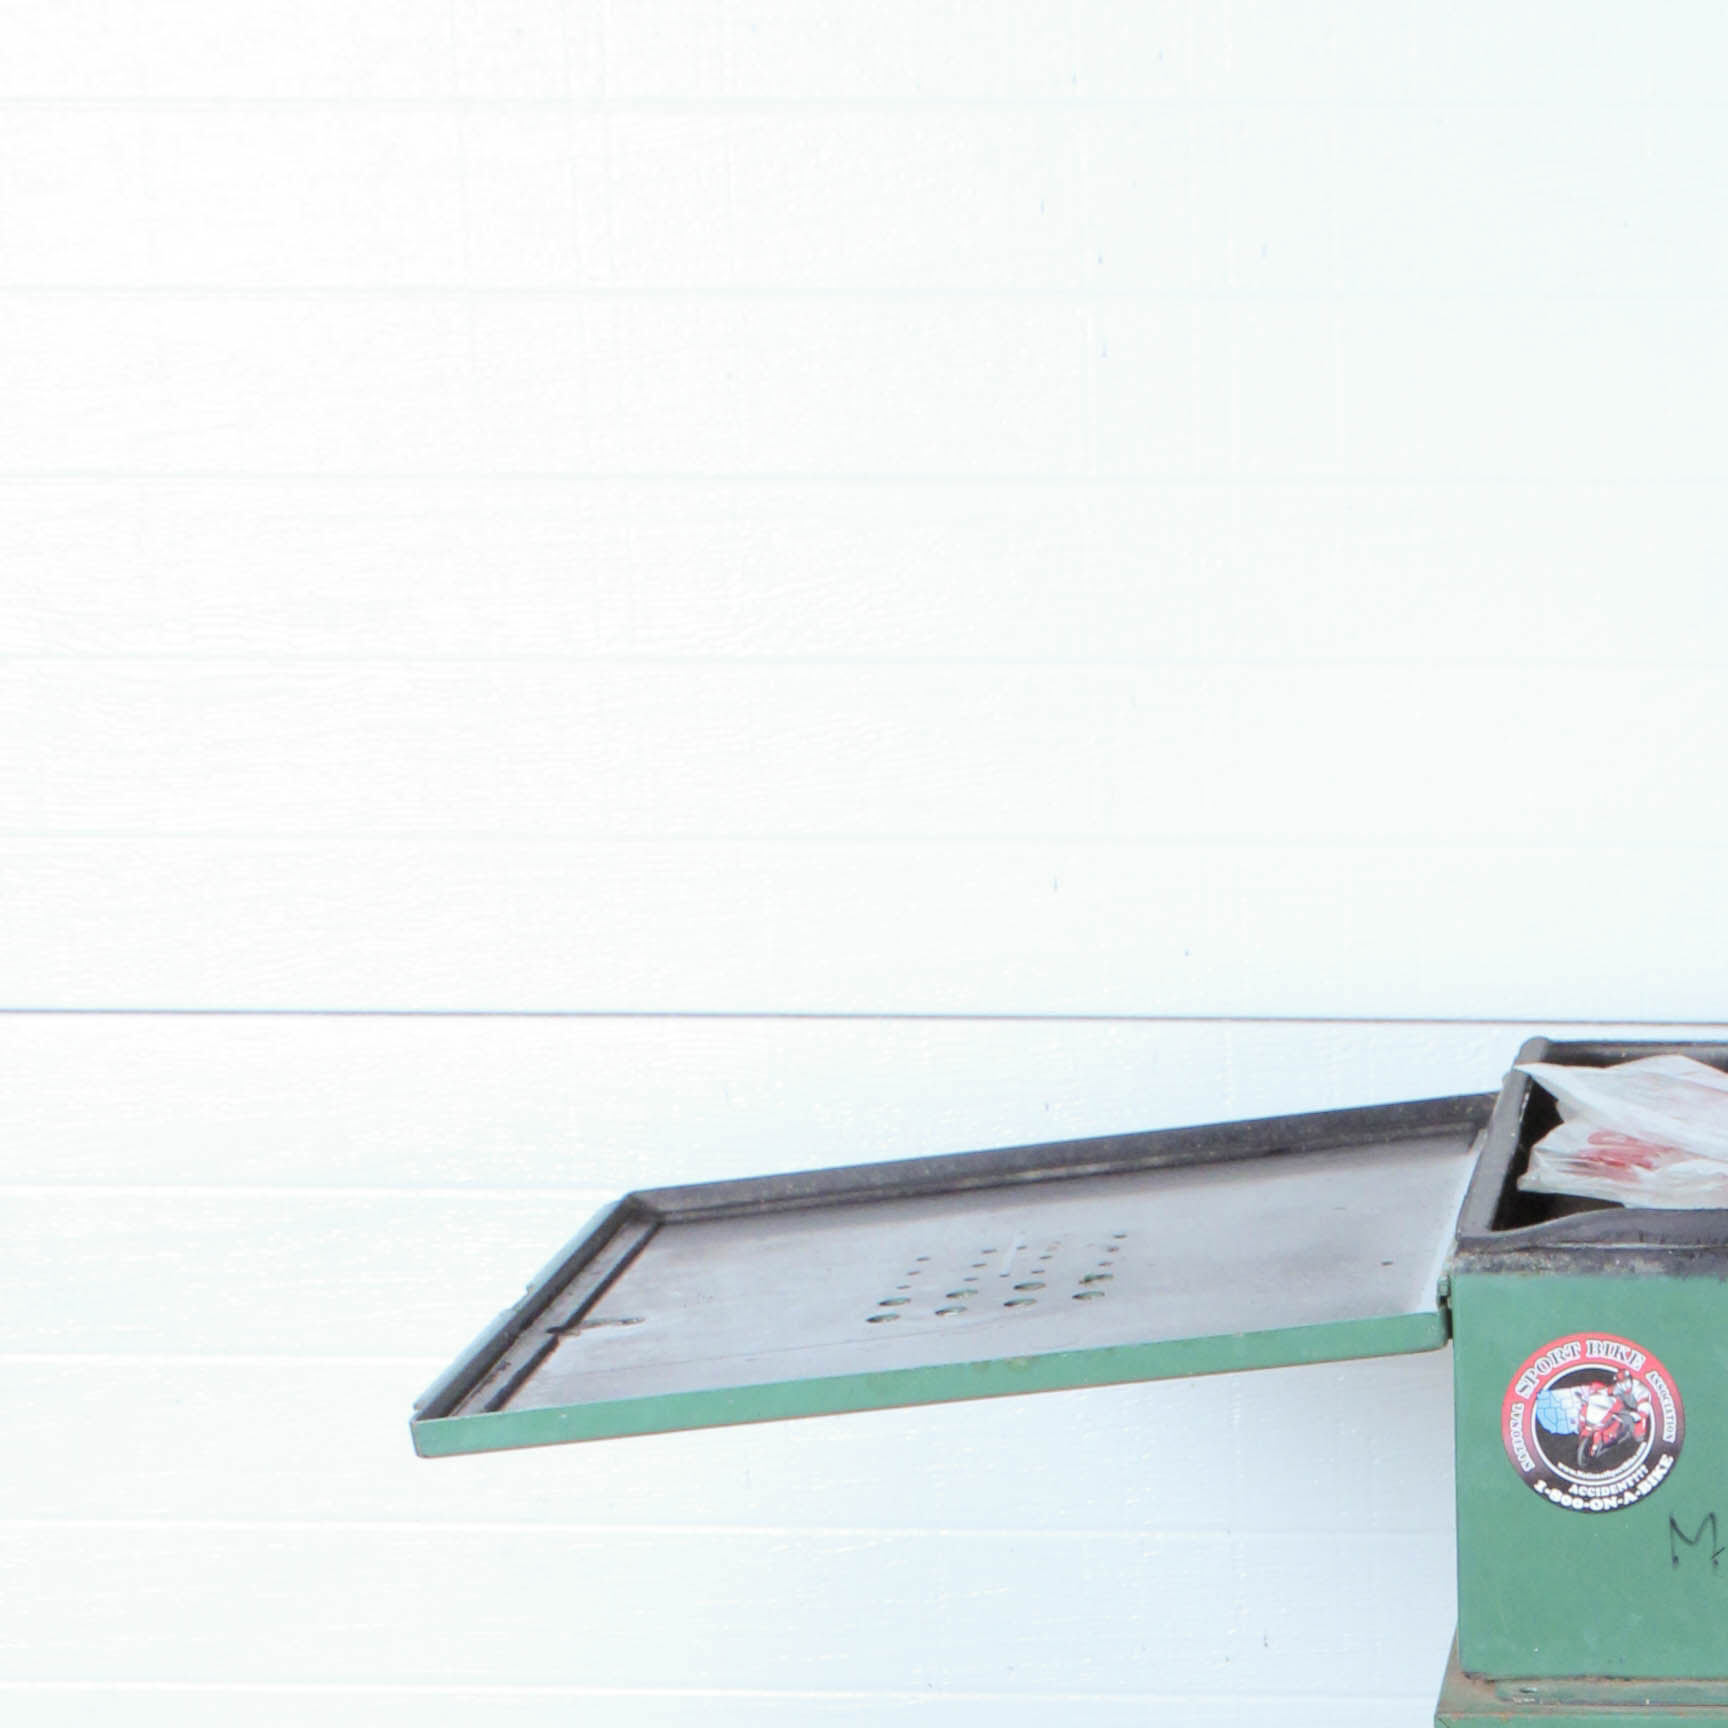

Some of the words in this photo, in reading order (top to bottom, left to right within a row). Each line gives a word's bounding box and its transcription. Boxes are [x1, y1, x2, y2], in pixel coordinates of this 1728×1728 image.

[1515, 1341, 1581, 1399] SPORT
[1586, 1340, 1647, 1372] BIKE
[1645, 1371, 1677, 1443] ASSOCIATION
[1510, 1403, 1536, 1472] NATIONAL
[1534, 1454, 1674, 1511] 1-800-ON-A-BIKE
